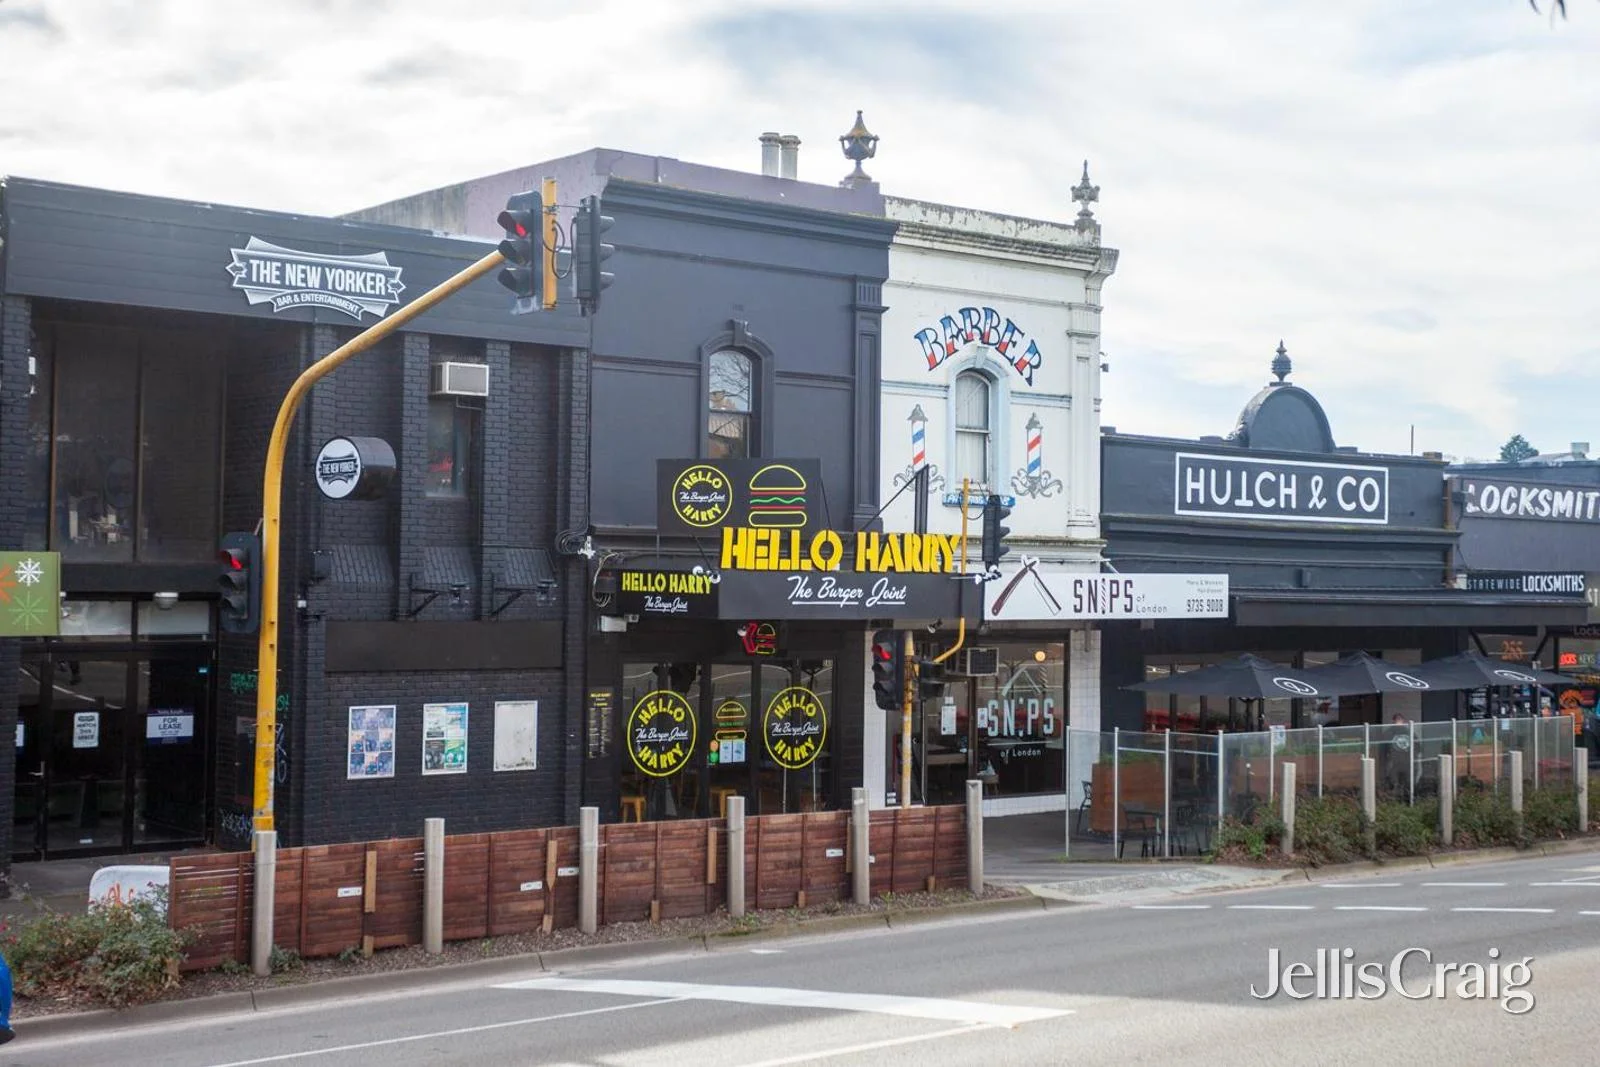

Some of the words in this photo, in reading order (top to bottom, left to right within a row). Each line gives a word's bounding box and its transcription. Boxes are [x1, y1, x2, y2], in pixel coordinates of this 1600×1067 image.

[249, 259, 281, 284] THE
[285, 263, 320, 289] NEW
[325, 267, 386, 296] YORKER
[276, 293, 293, 306] BAR
[294, 294, 299, 303] &
[300, 293, 360, 315] ENTERTAINMENT
[914, 307, 1041, 387] BARBER
[682, 471, 722, 489] HELLO
[1186, 467, 1296, 509] HUTCH
[1308, 475, 1327, 510] &
[1336, 476, 1380, 513] CO
[683, 503, 721, 521] HARRY
[1466, 484, 1600, 520] LOCKSMIT
[720, 527, 843, 572] HELLO
[854, 531, 961, 573] HARRY
[622, 572, 666, 592] HELLO
[669, 573, 712, 594] HARRY
[787, 575, 813, 600] The
[817, 576, 864, 608] Burger
[865, 577, 907, 607] Joint
[1523, 575, 1584, 592] LOCKSMITHS
[644, 596, 654, 608] The
[655, 596, 672, 611] Burger
[671, 597, 688, 612] Joint
[1073, 578, 1133, 614] SNIPS
[1136, 594, 1145, 602] of
[1136, 605, 1168, 613] London
[638, 698, 685, 725] HELLO
[773, 694, 816, 720] HELLO
[635, 728, 647, 740] The
[648, 728, 669, 741] Burger
[668, 727, 689, 742] Joint
[771, 723, 782, 734] The
[782, 723, 802, 735] Burger
[801, 722, 820, 735] Joint
[638, 742, 684, 769] HARRY
[773, 737, 816, 761] HARRY
[1012, 749, 1042, 757] London
